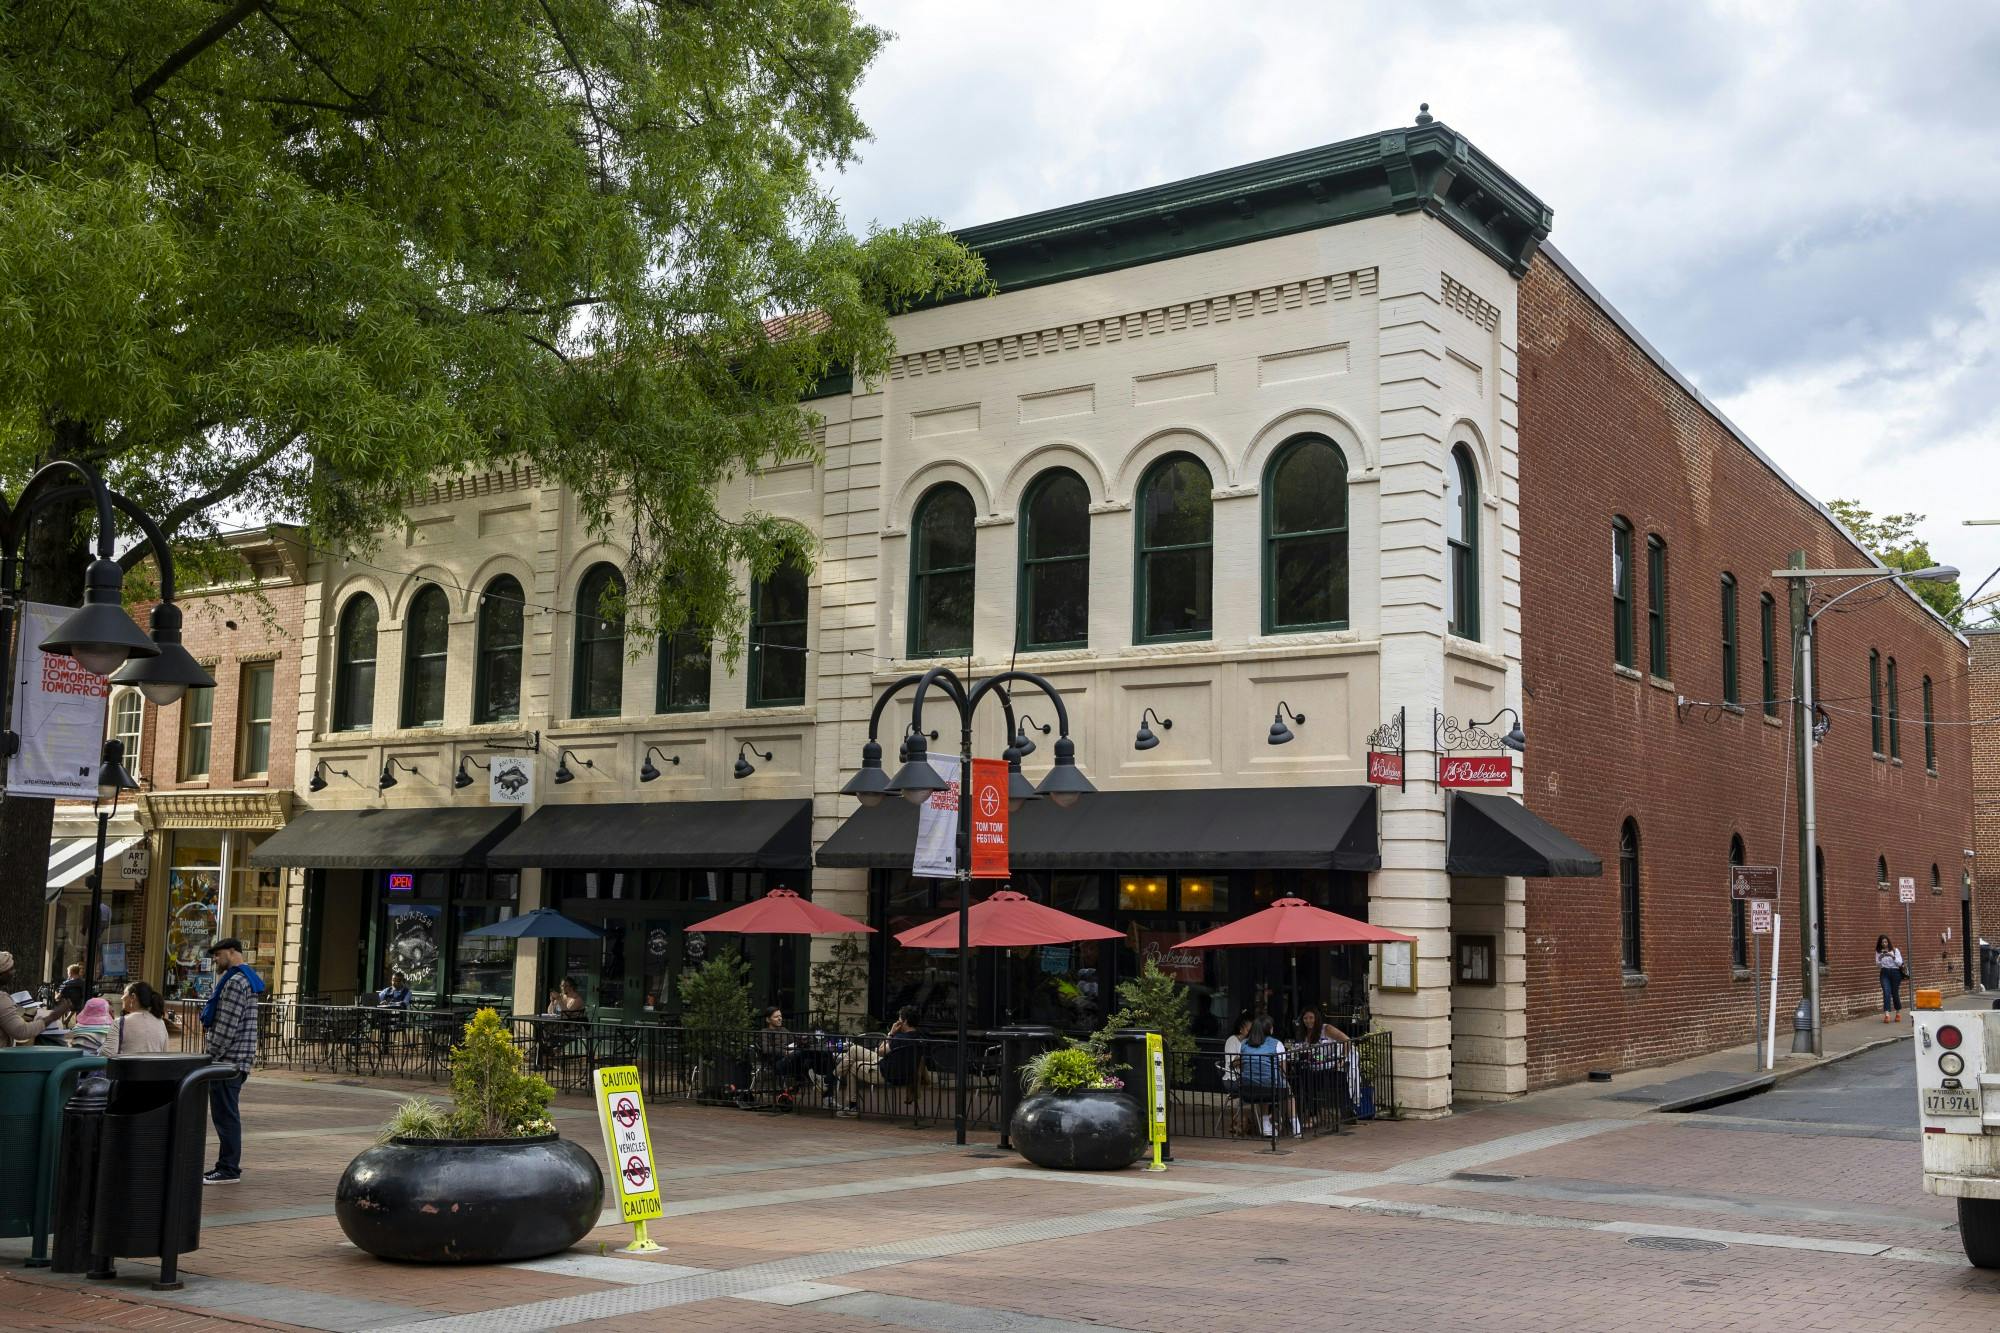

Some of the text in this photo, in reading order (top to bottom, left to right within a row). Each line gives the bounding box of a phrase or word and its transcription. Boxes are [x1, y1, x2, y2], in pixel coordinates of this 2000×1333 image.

[43, 669, 108, 686] TOMORROW
[42, 681, 108, 697] TOMORROW
[1460, 762, 1507, 781] Bebedero
[976, 822, 1003, 832] TOM TOM
[976, 834, 1004, 844] FESTIVAL
[128, 852, 144, 860] ART
[391, 876, 412, 888] OPEN
[180, 918, 205, 928] Telegraph
[602, 1071, 639, 1087] CAUTION
[1928, 1096, 1979, 1110] 171-974L
[626, 1131, 636, 1141] NO
[619, 1142, 646, 1154] VEHICLES
[624, 1197, 661, 1217] CAUTION
